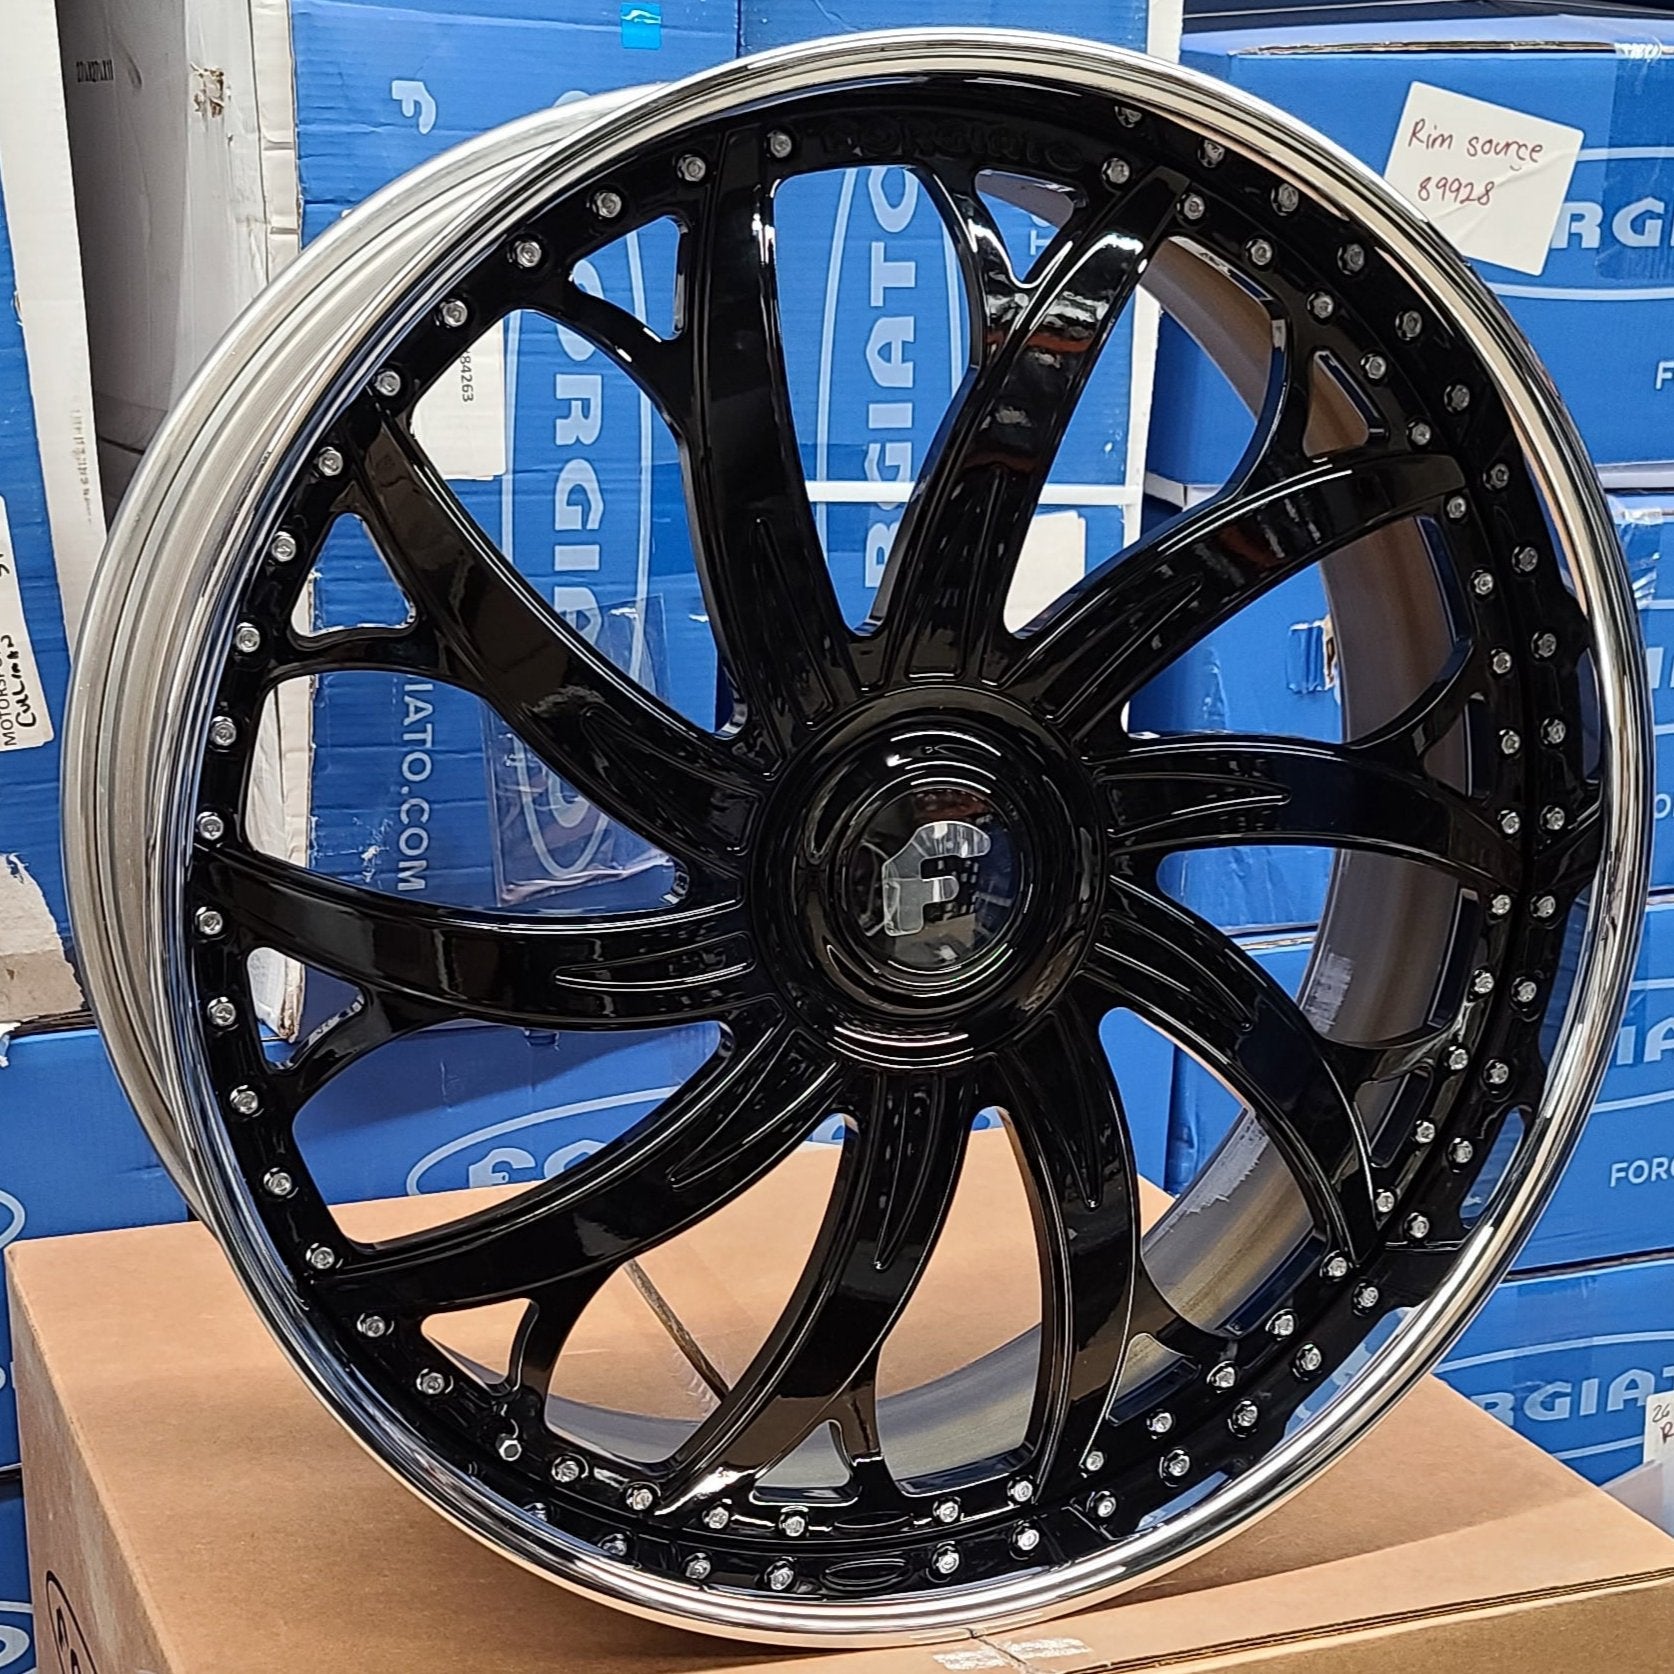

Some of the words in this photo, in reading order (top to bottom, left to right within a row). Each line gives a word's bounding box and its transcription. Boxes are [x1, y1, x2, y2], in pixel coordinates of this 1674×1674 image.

[1407, 118, 1454, 150] Rim
[1417, 176, 1496, 206] 89928
[460, 350, 474, 402] 84263
[396, 682, 435, 891] IATO.COM
